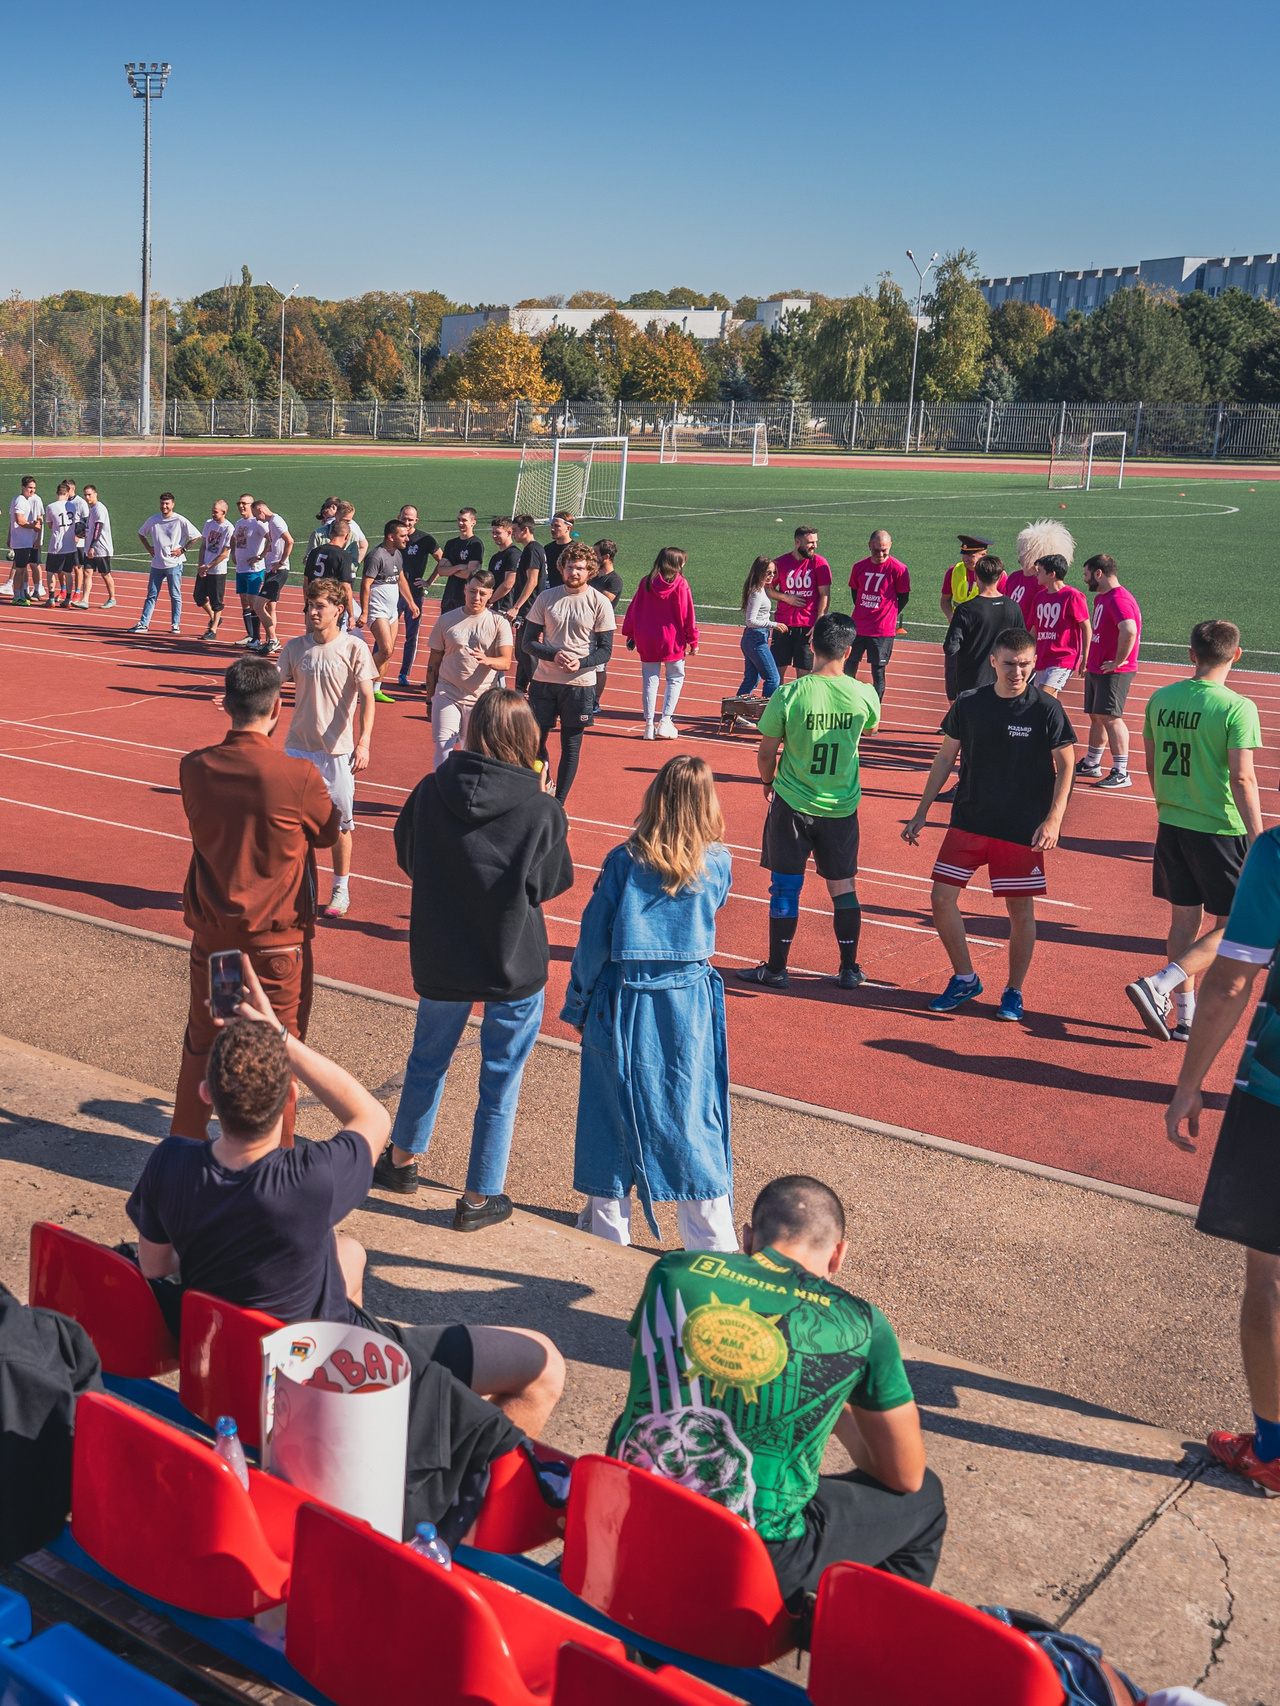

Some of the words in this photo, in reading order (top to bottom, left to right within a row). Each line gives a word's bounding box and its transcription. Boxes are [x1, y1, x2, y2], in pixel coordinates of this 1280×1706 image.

[58, 511, 75, 528] 13
[313, 553, 329, 577] 5
[786, 569, 812, 589] 666
[864, 572, 885, 592] 77
[1036, 603, 1061, 629] 999
[806, 712, 853, 731] BRUNO
[1157, 708, 1202, 730] KARLO
[810, 743, 839, 775] 91
[1162, 741, 1191, 777] 28
[720, 1268, 787, 1295] SINDIKA
[794, 1288, 831, 1307] MNG
[720, 1337, 745, 1350] MMA
[710, 1354, 743, 1371] UNION
